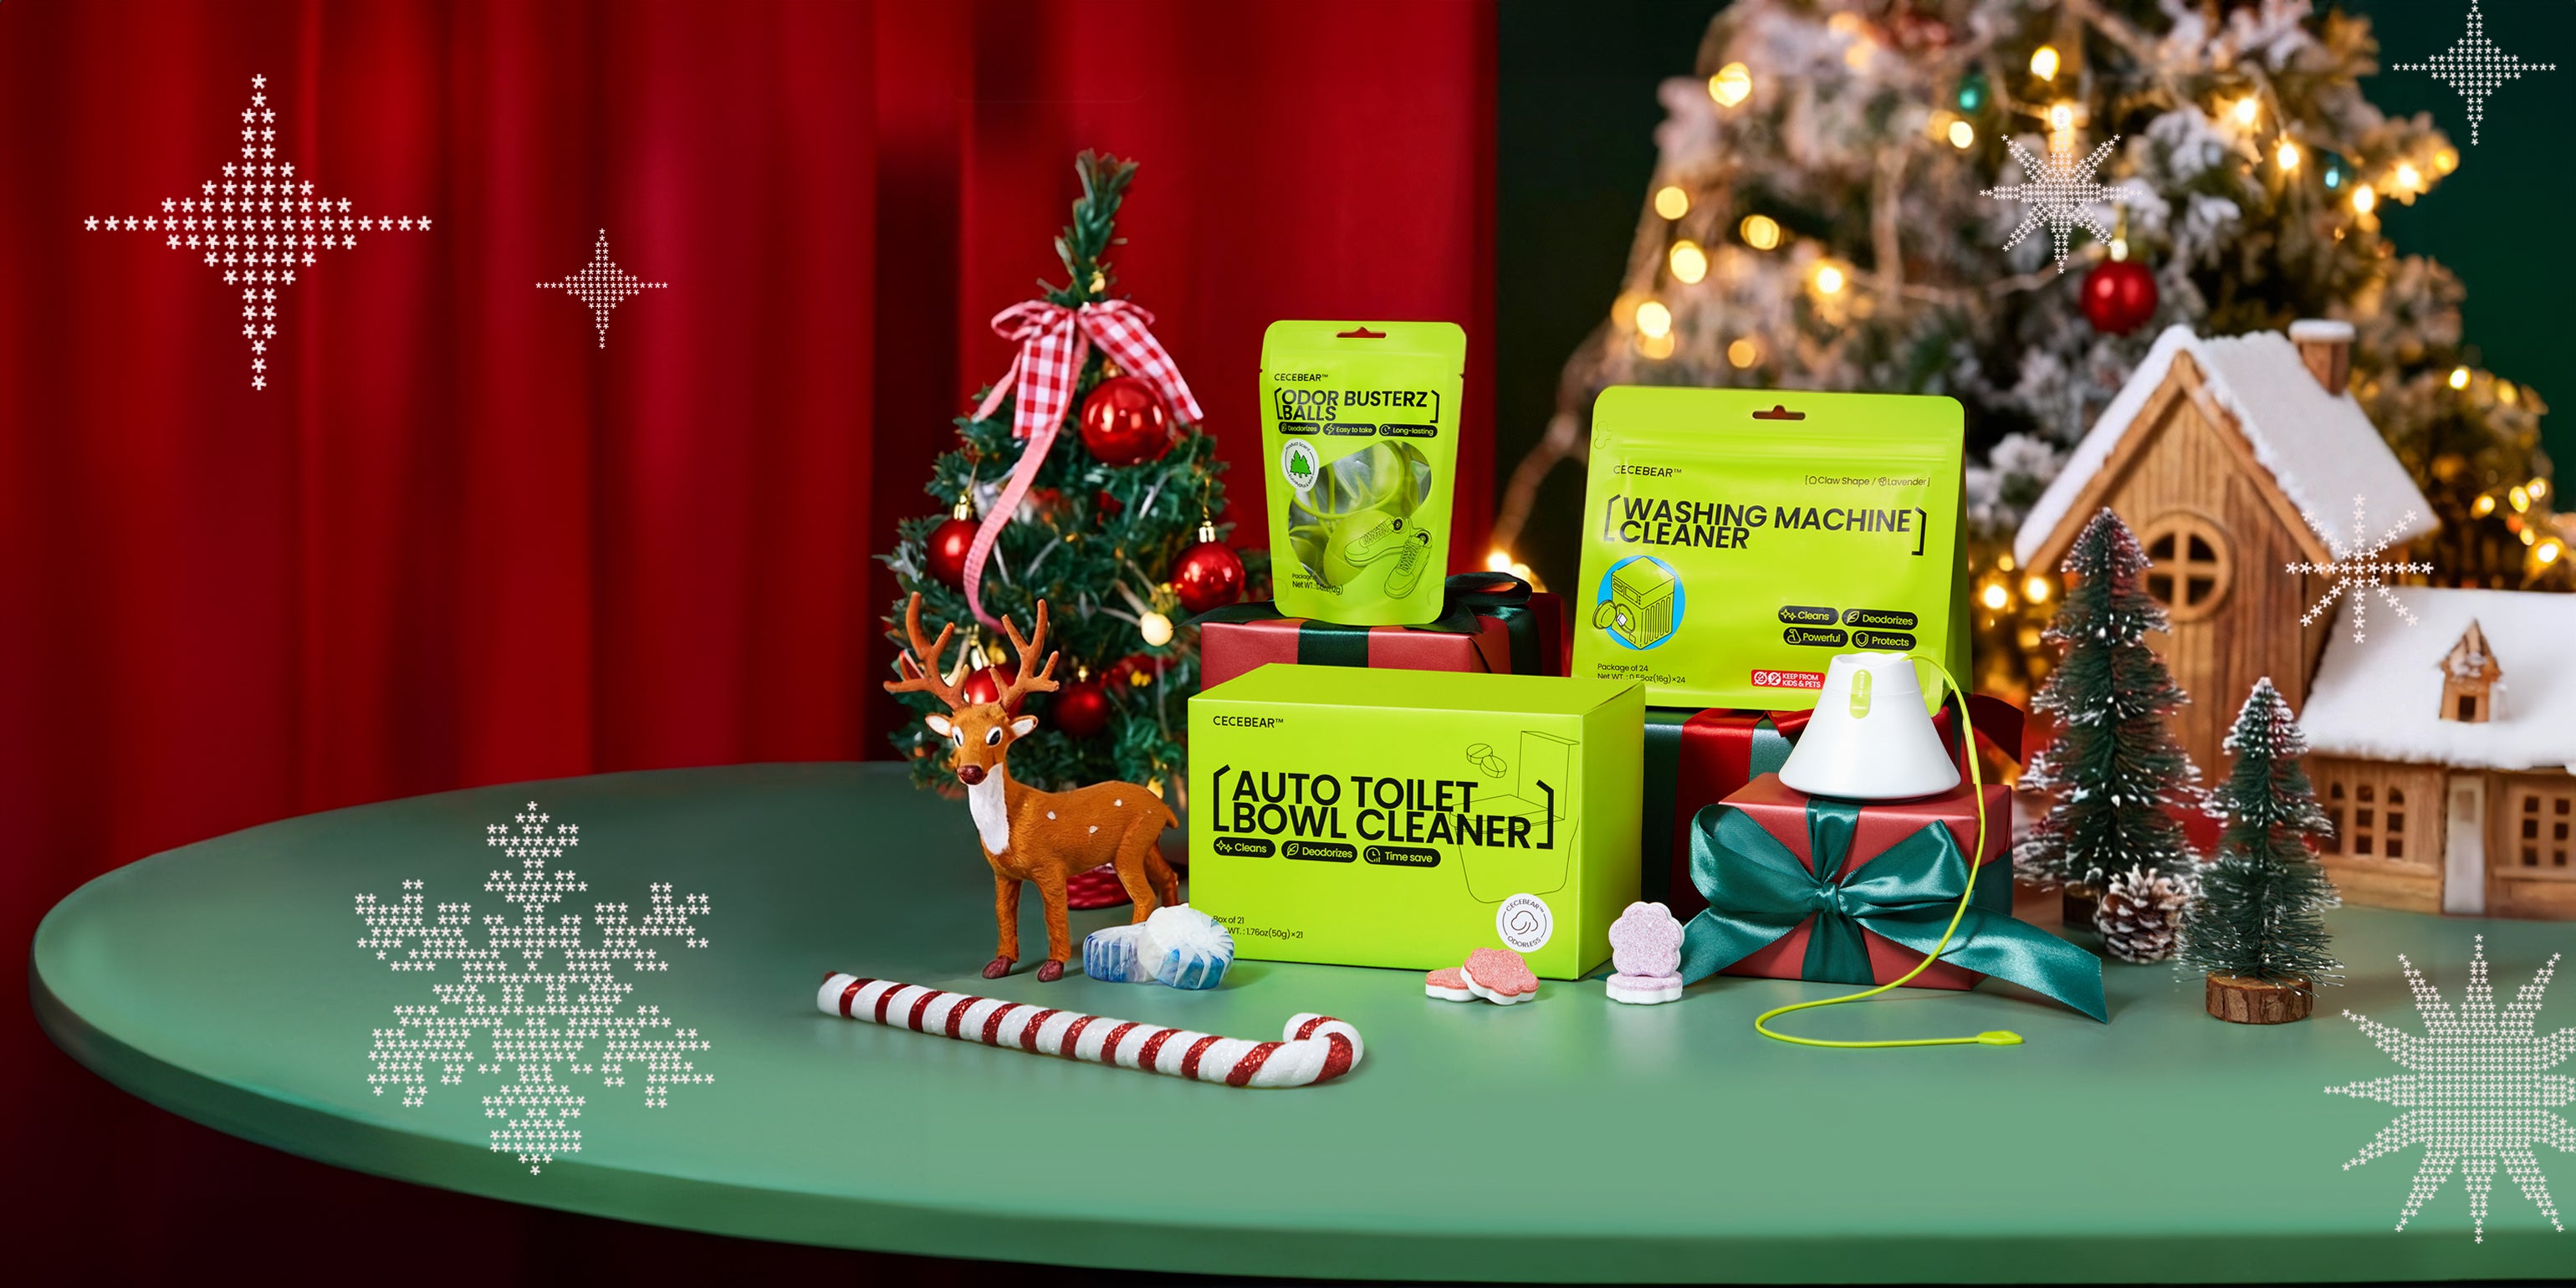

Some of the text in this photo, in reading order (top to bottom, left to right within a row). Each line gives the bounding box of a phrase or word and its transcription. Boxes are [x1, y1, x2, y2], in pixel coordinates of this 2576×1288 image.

[1281, 389, 1428, 407] ODOR BUSTERZ
[1282, 404, 1337, 422] BALLS
[1393, 427, 1434, 437] Long-lasting
[1817, 476, 1840, 484] Claw
[1842, 476, 1870, 488] Shape
[1623, 497, 1912, 532] WASHING MACHINE
[1619, 520, 1750, 549] CLEANER
[1797, 611, 1829, 621] Cleans
[1862, 614, 1914, 626] Deodorizes
[1802, 632, 1841, 642] Powerful
[1872, 636, 1909, 647] Protects
[1597, 663, 1629, 672] Package
[1232, 770, 1479, 813] AUTO TOILET
[1234, 802, 1531, 849] BOWL CLEANER
[1234, 842, 1267, 853] Cleans
[1302, 846, 1353, 859] Deodorizes
[1384, 851, 1433, 863] Time save
[1507, 935, 1541, 948] ODORLESS
